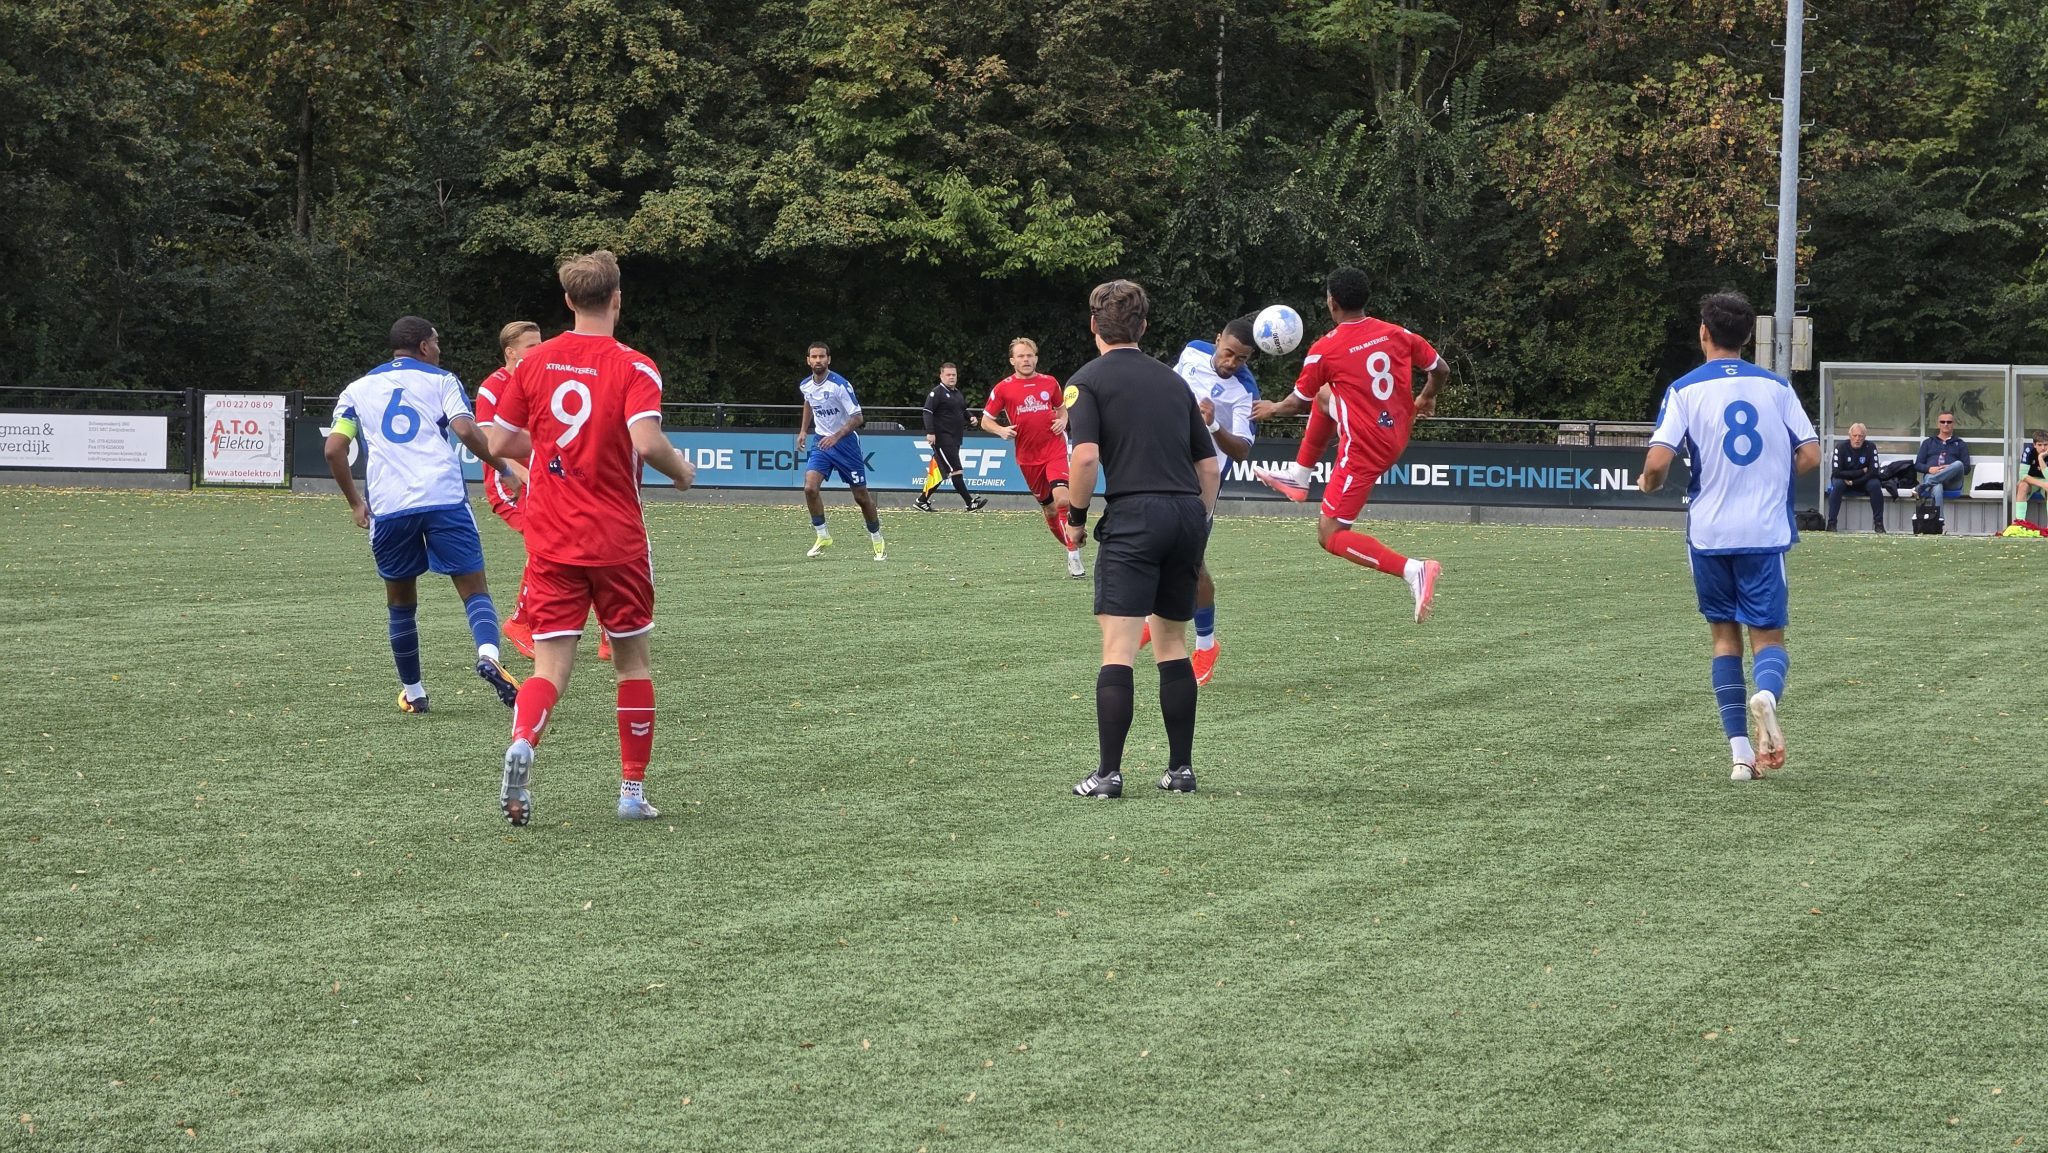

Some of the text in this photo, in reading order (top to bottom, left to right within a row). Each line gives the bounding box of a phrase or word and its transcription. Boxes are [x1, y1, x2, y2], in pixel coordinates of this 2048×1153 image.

[1366, 351, 1394, 400] 8
[234, 401, 249, 409] 227
[381, 388, 421, 444] 6
[551, 380, 592, 448] 9
[0, 423, 54, 437] gman &
[213, 420, 263, 436] A.T.O.
[1723, 400, 1763, 467] 8
[0, 440, 50, 455] verdijk
[219, 436, 264, 450] Elektro
[697, 448, 733, 470] DE
[740, 449, 875, 472] TECHK
[208, 470, 281, 478] www.atoelektro.nl
[851, 471, 859, 483] 5
[967, 478, 1006, 487] TECHNIEK
